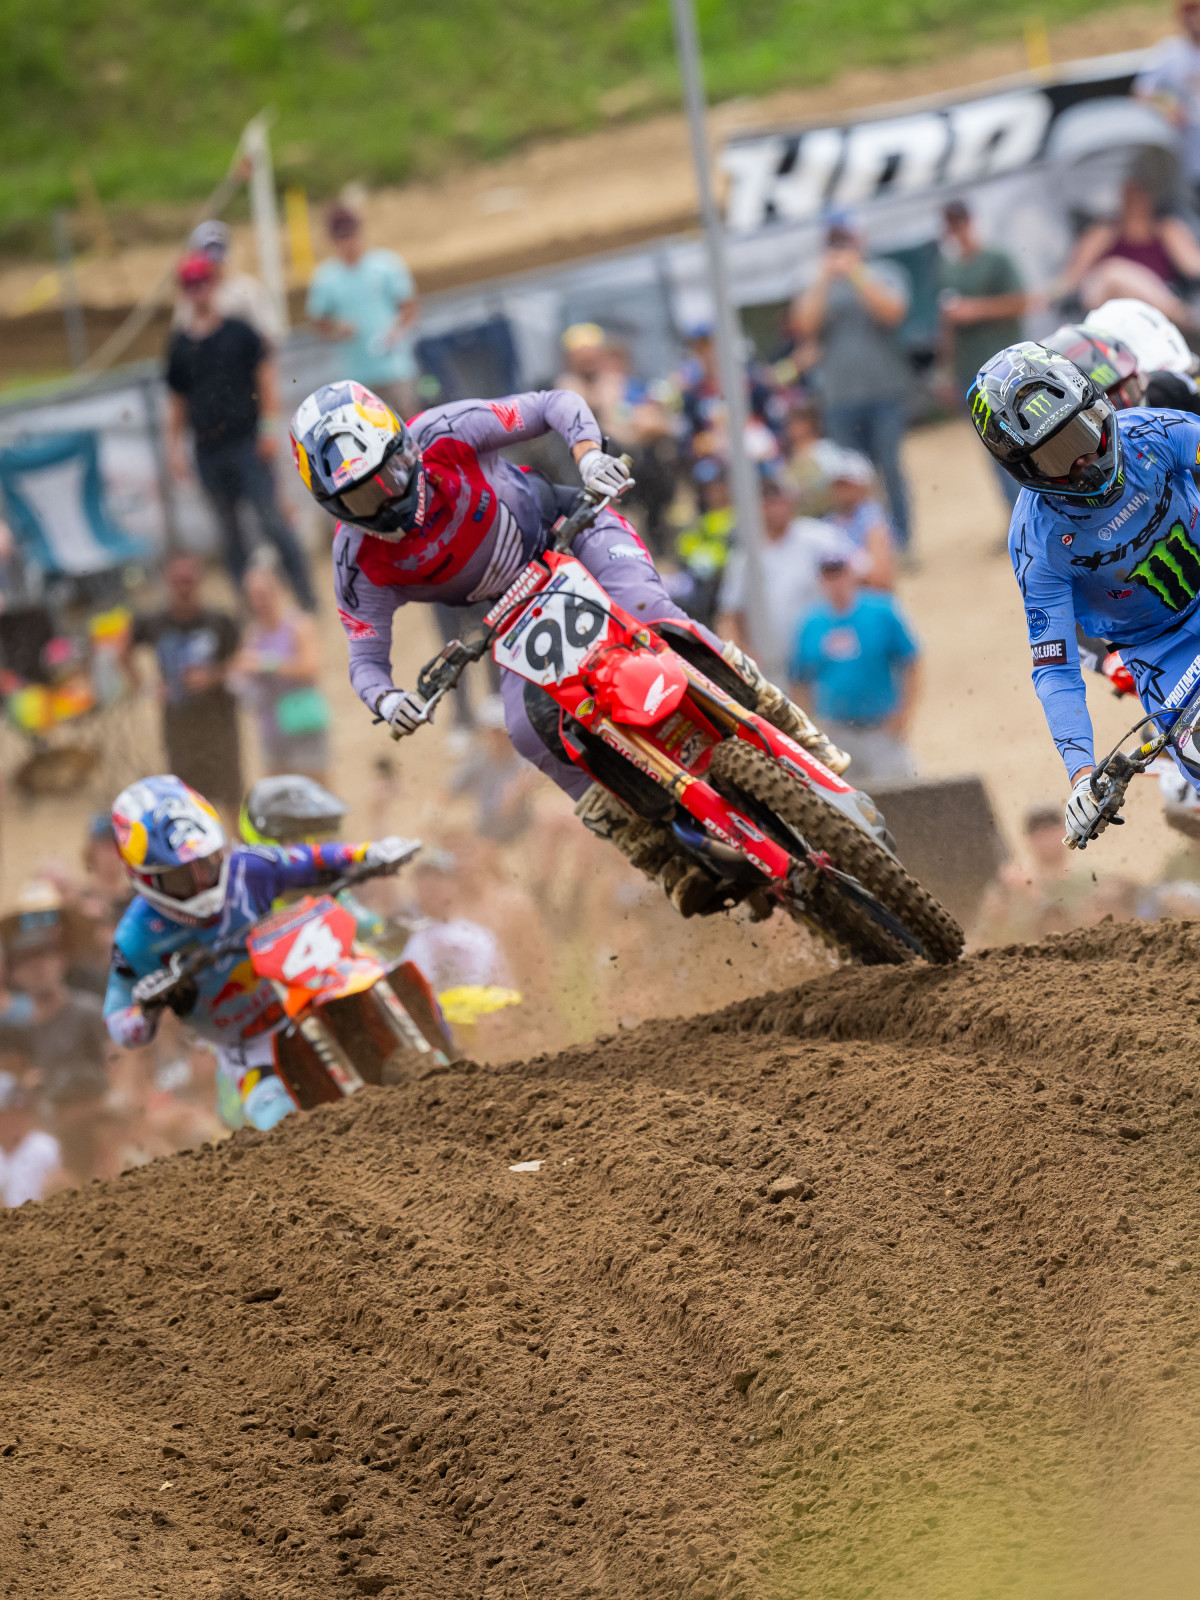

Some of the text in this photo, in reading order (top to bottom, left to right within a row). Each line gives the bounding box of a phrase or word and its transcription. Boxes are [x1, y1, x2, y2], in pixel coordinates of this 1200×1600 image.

[1107, 491, 1151, 532] YAMAHA
[486, 566, 536, 623] RENTHAL
[525, 585, 606, 687] 96
[281, 914, 343, 981] 4
